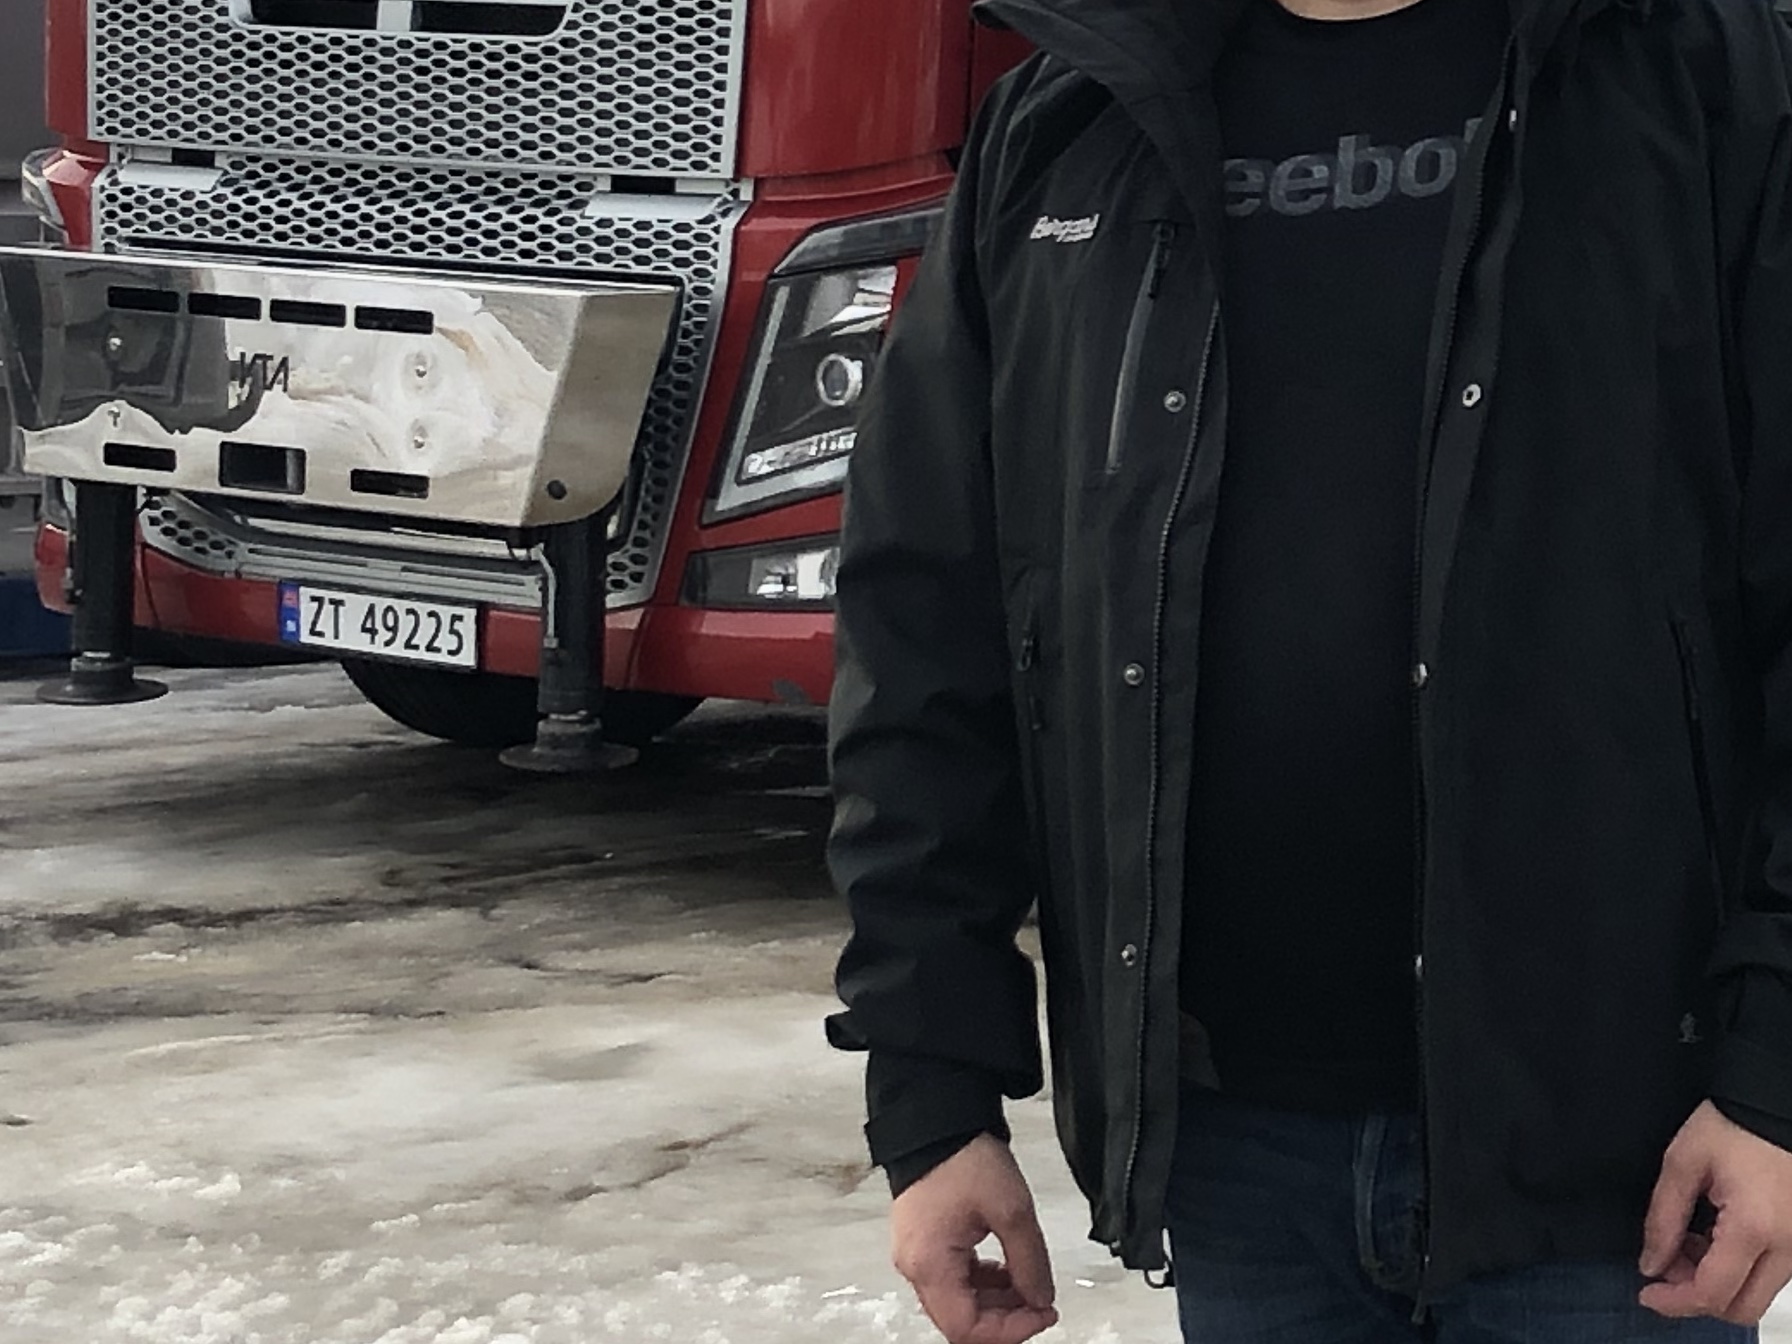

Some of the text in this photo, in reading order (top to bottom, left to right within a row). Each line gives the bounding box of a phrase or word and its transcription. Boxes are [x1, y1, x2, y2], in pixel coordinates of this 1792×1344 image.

[1223, 117, 1482, 216] eebo
[308, 595, 465, 657] ZT 49225
